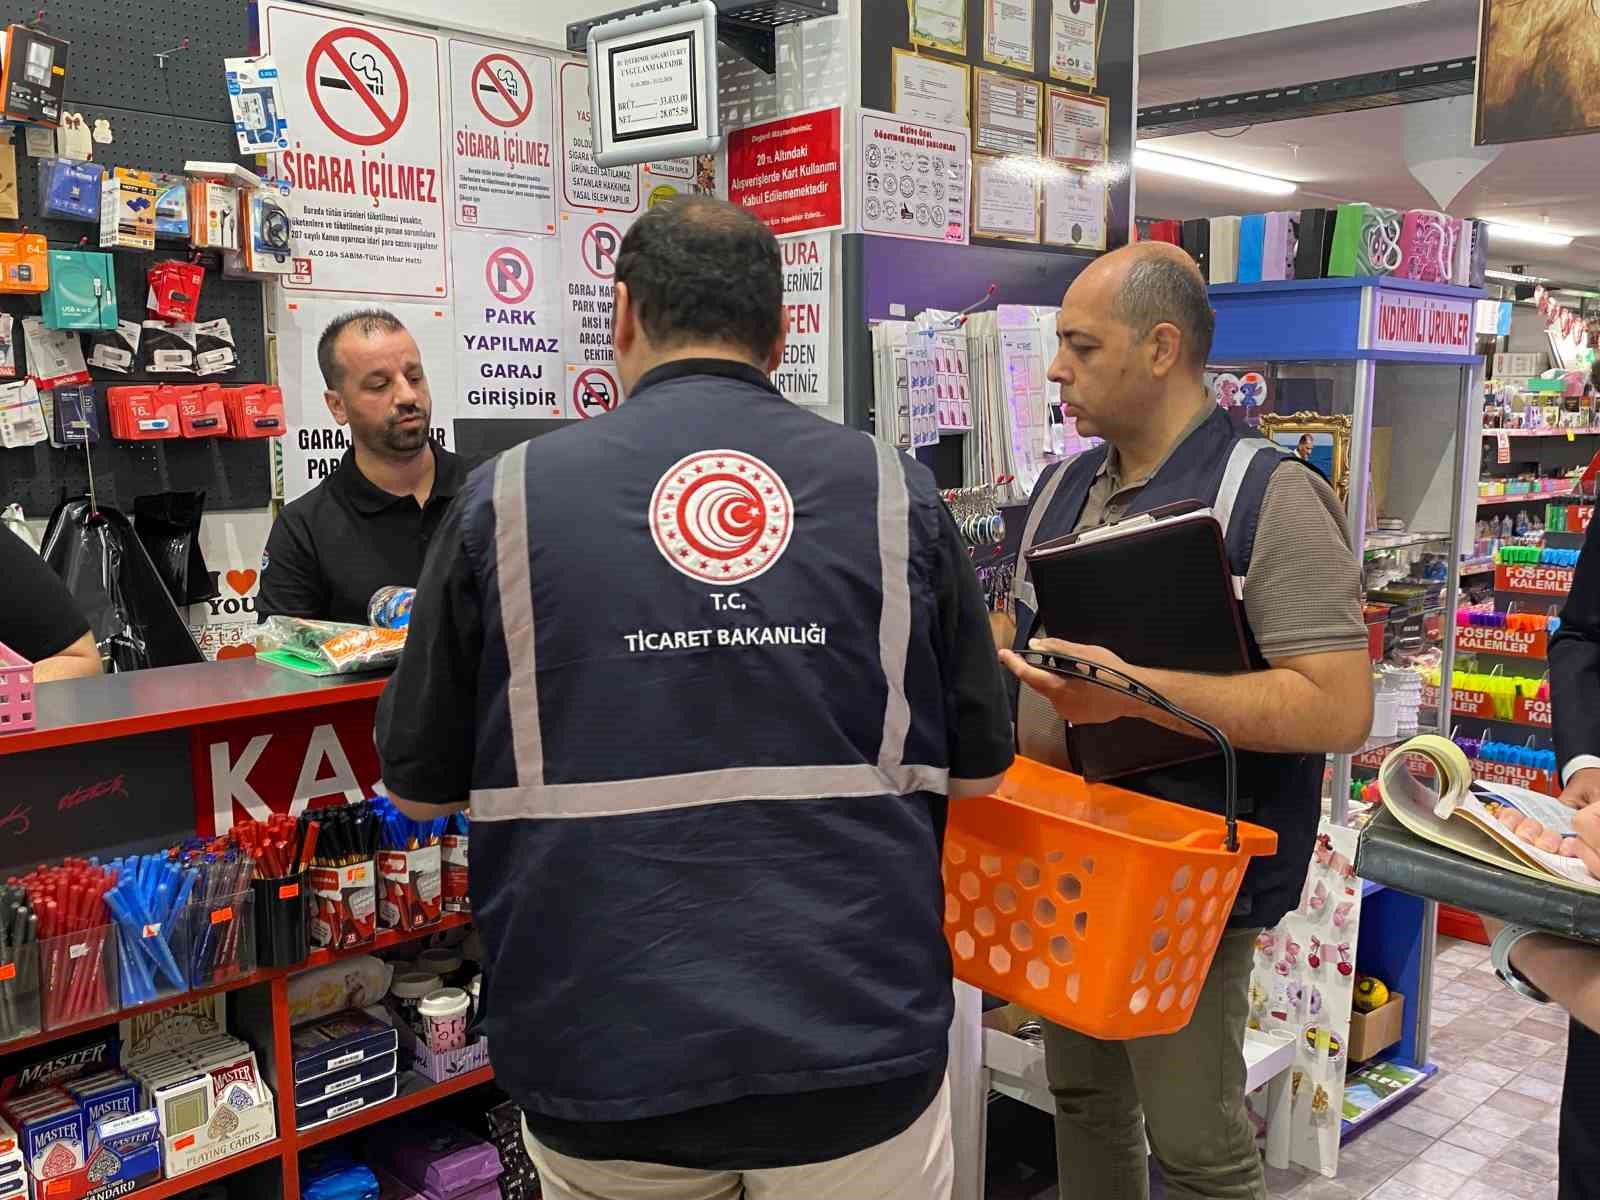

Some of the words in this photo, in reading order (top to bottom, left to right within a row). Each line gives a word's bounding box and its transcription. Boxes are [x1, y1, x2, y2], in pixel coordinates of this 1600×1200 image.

[618, 115, 631, 124] NET
[456, 124, 500, 160] SİGARA
[504, 131, 550, 169] İÇİLMEZ
[756, 154, 765, 166] 20
[774, 144, 808, 162] Altındaki
[283, 142, 357, 195] SİGARA
[361, 150, 438, 208] İÇİLMEZ
[732, 171, 780, 192] Alışverişlerde
[782, 167, 798, 180] Kart
[800, 161, 837, 176] Kullanımı
[572, 190, 591, 201] YASAL
[742, 193, 762, 208] Kabul
[764, 181, 828, 203] Edilememektedir
[304, 206, 324, 216] Burada
[326, 208, 342, 218] tütün
[291, 219, 324, 229] üketenlere
[291, 230, 303, 239] 207
[304, 231, 320, 242] sayılı
[322, 232, 340, 242] Kanun
[783, 240, 818, 265] URA
[783, 268, 822, 292] LERİNİZİ
[569, 283, 596, 297] GARAJ
[600, 284, 615, 297] KAP
[573, 300, 594, 312] PARK
[597, 302, 613, 314] YAP
[485, 308, 536, 325] PARK
[787, 304, 820, 334] FEN
[1378, 296, 1425, 343] İNDİRİMLİ
[1428, 303, 1469, 346] ÜRÜNLER
[464, 335, 560, 353] YAPILMAZ
[580, 334, 614, 346] ARAÇLA
[584, 346, 614, 362] ÇEKTİR
[784, 344, 816, 364] EDEN
[480, 364, 542, 378] GARAJ
[468, 388, 556, 410] GİRİŞİDİR
[131, 406, 144, 416] 16
[182, 406, 196, 416] 32
[245, 406, 258, 416] 64
[308, 458, 342, 479] PAR
[1506, 566, 1574, 582] FOSFORL
[1510, 578, 1572, 592] KALEMLE
[208, 597, 256, 615] YOU
[710, 593, 746, 610] T.C.
[624, 630, 713, 652] TİCARET
[717, 623, 826, 646] BAKANLIĞI
[1455, 626, 1536, 644] FOSFORLU
[1458, 637, 1528, 654] KALEMLER
[1524, 700, 1552, 712] FOS
[210, 723, 365, 838] KA
[20, 1043, 107, 1088] MASTER
[214, 1066, 252, 1096] MASTER
[89, 1096, 130, 1124] MASTER
[34, 1122, 78, 1152] MASTER
[186, 1146, 227, 1168] PLAYING
[230, 1132, 260, 1151] CARDS
